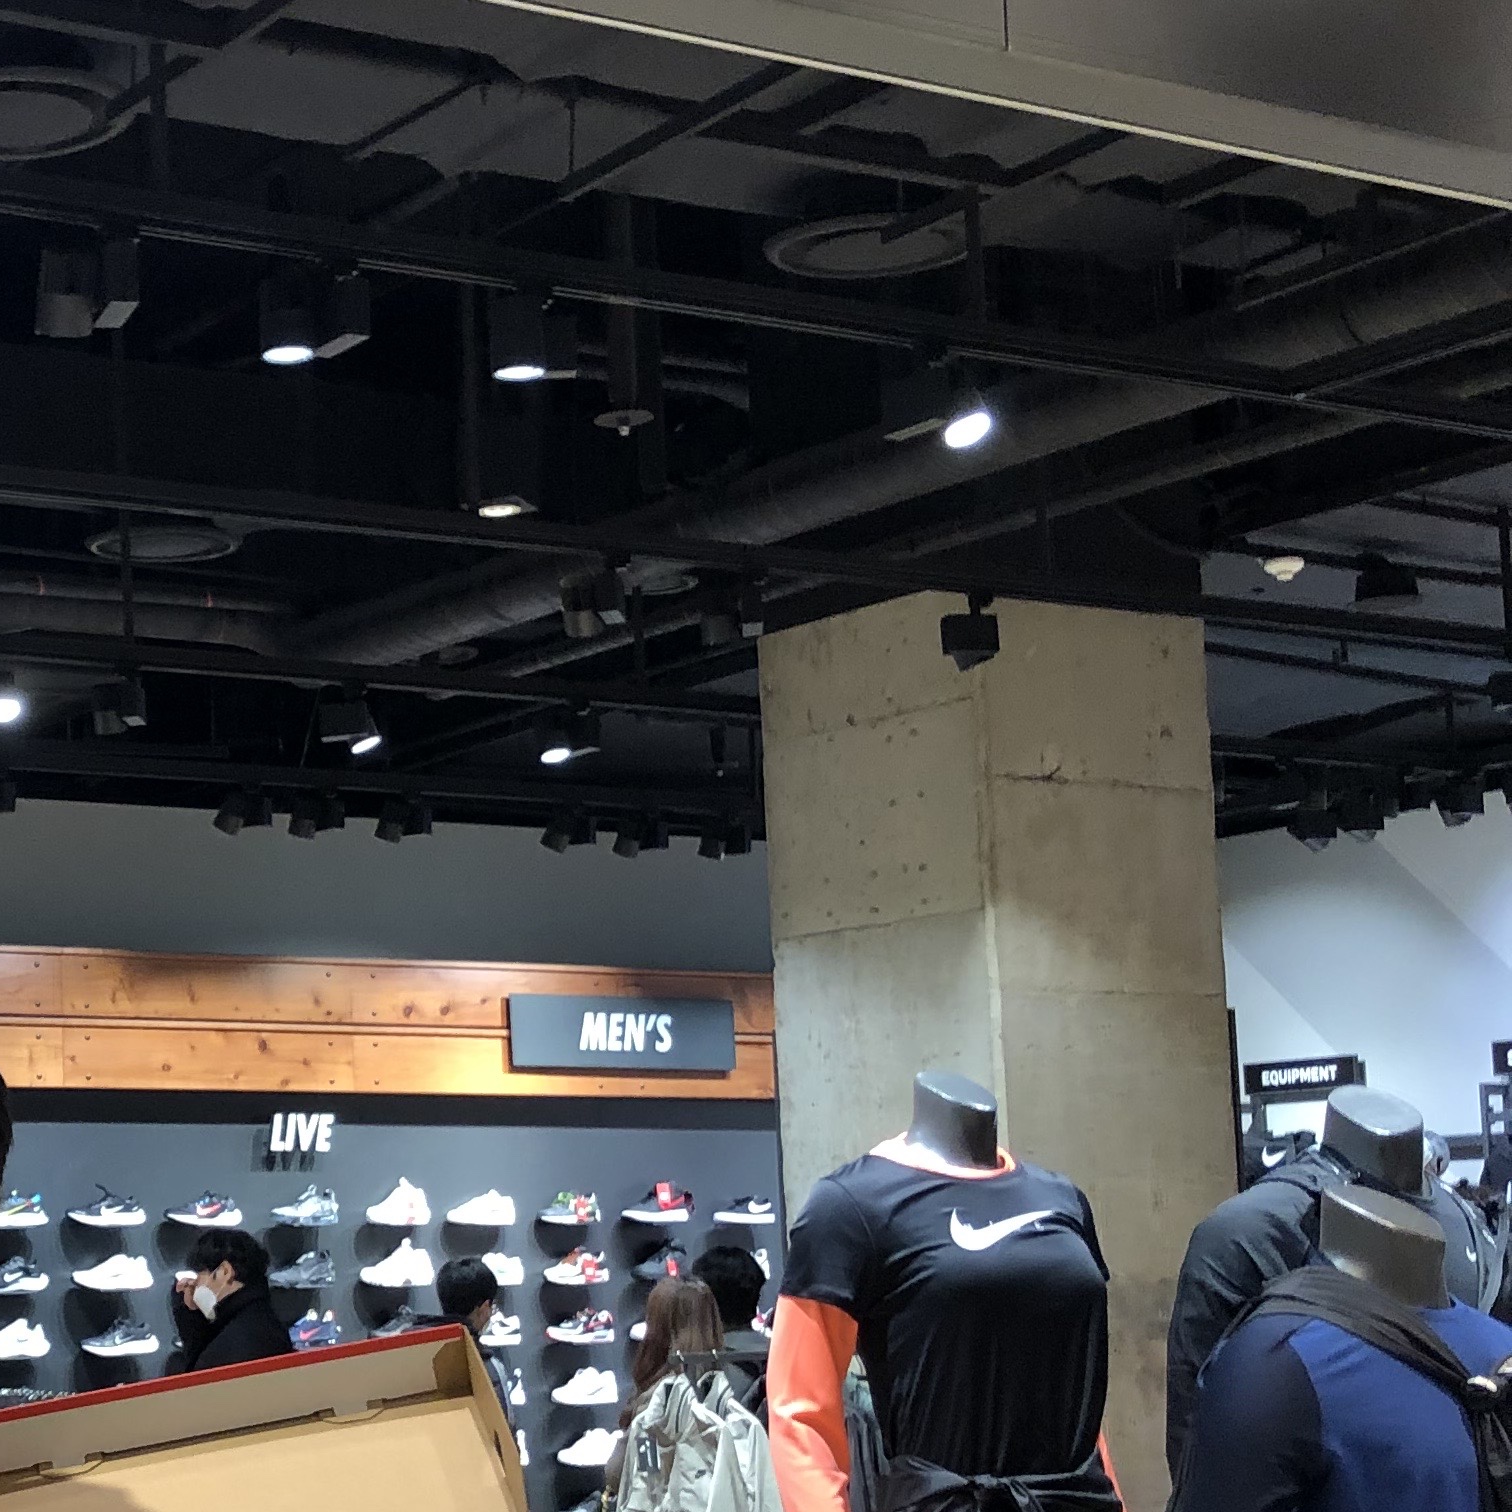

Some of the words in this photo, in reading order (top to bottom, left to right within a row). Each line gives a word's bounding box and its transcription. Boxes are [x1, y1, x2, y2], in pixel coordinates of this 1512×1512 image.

[579, 1011, 672, 1053] MEN'S
[1261, 1064, 1338, 1087] EQUIPMENT
[270, 1112, 335, 1152] LIVE
